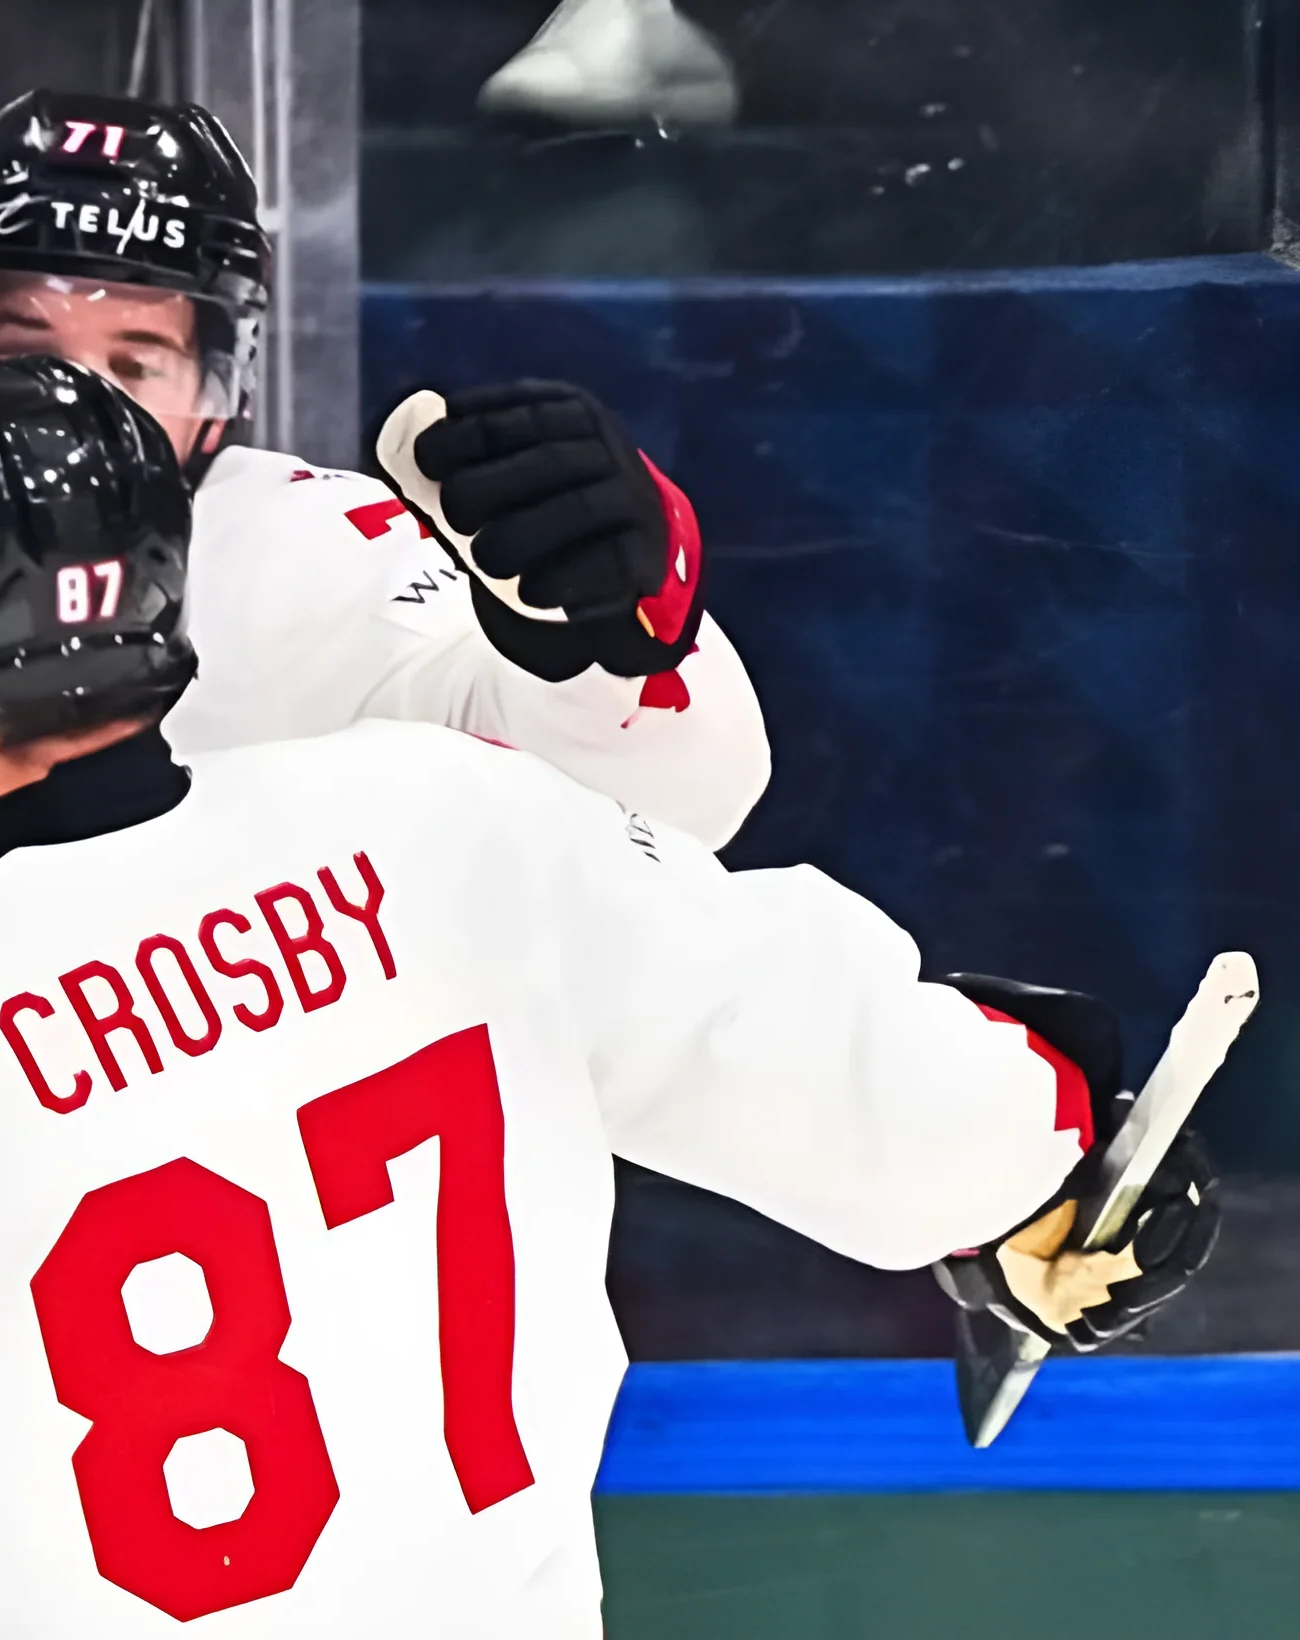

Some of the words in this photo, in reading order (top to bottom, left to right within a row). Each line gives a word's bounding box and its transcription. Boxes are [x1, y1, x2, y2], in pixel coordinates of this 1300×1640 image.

[61, 120, 125, 161] 71
[51, 202, 186, 249] TELUS
[56, 559, 124, 624] 87
[30, 1023, 535, 1622] 87
